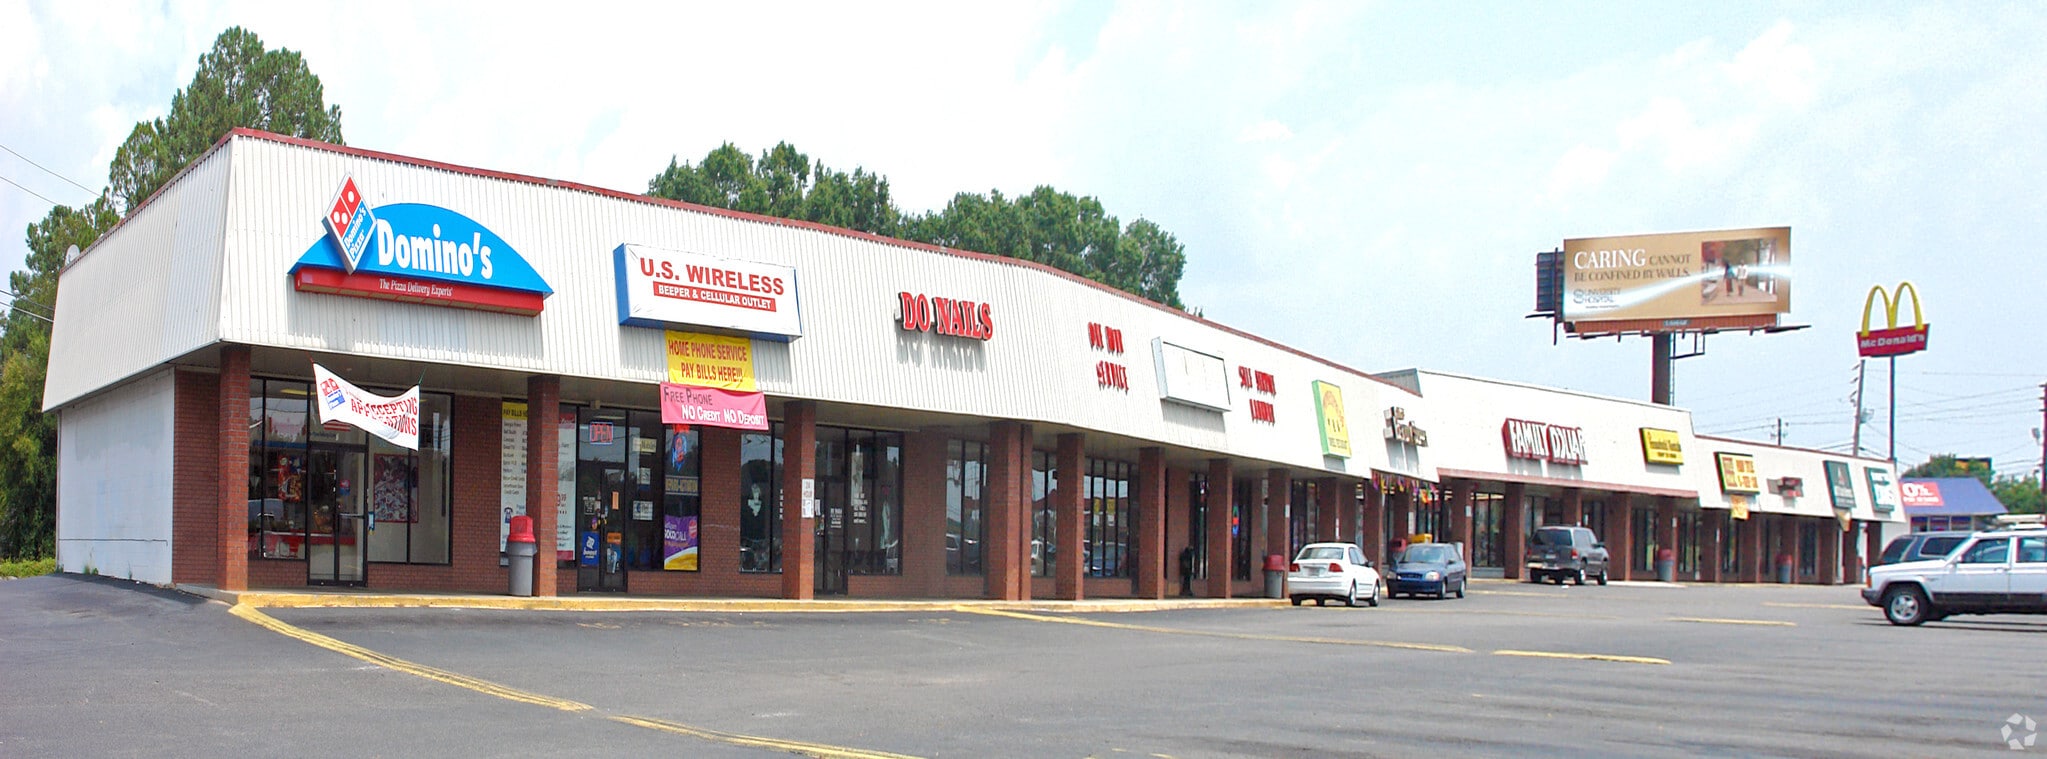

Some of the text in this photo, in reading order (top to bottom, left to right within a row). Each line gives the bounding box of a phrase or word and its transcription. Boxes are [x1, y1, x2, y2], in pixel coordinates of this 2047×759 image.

[344, 206, 367, 251] Domino's
[376, 218, 493, 279] Domino's
[1574, 249, 1691, 270] CARING CANNOT
[640, 257, 784, 295] U.S. WIRELESS
[1574, 270, 1588, 282] BE
[1588, 268, 1641, 282] CONFINED
[1641, 268, 1656, 280] BY
[379, 278, 390, 290] The
[390, 279, 407, 293] Pizza
[407, 281, 431, 297] Delivery
[658, 284, 772, 310] BEEPER & CELLULAR OUTLET
[900, 291, 994, 341] DO NAILS
[668, 339, 748, 362] HOME PHONE SERVICE
[681, 362, 694, 379] PAY
[696, 364, 716, 380] BILLS
[681, 405, 696, 421] NO
[723, 408, 737, 423] NO
[590, 423, 613, 443] OPEN
[1505, 418, 1549, 457] FAMILY
